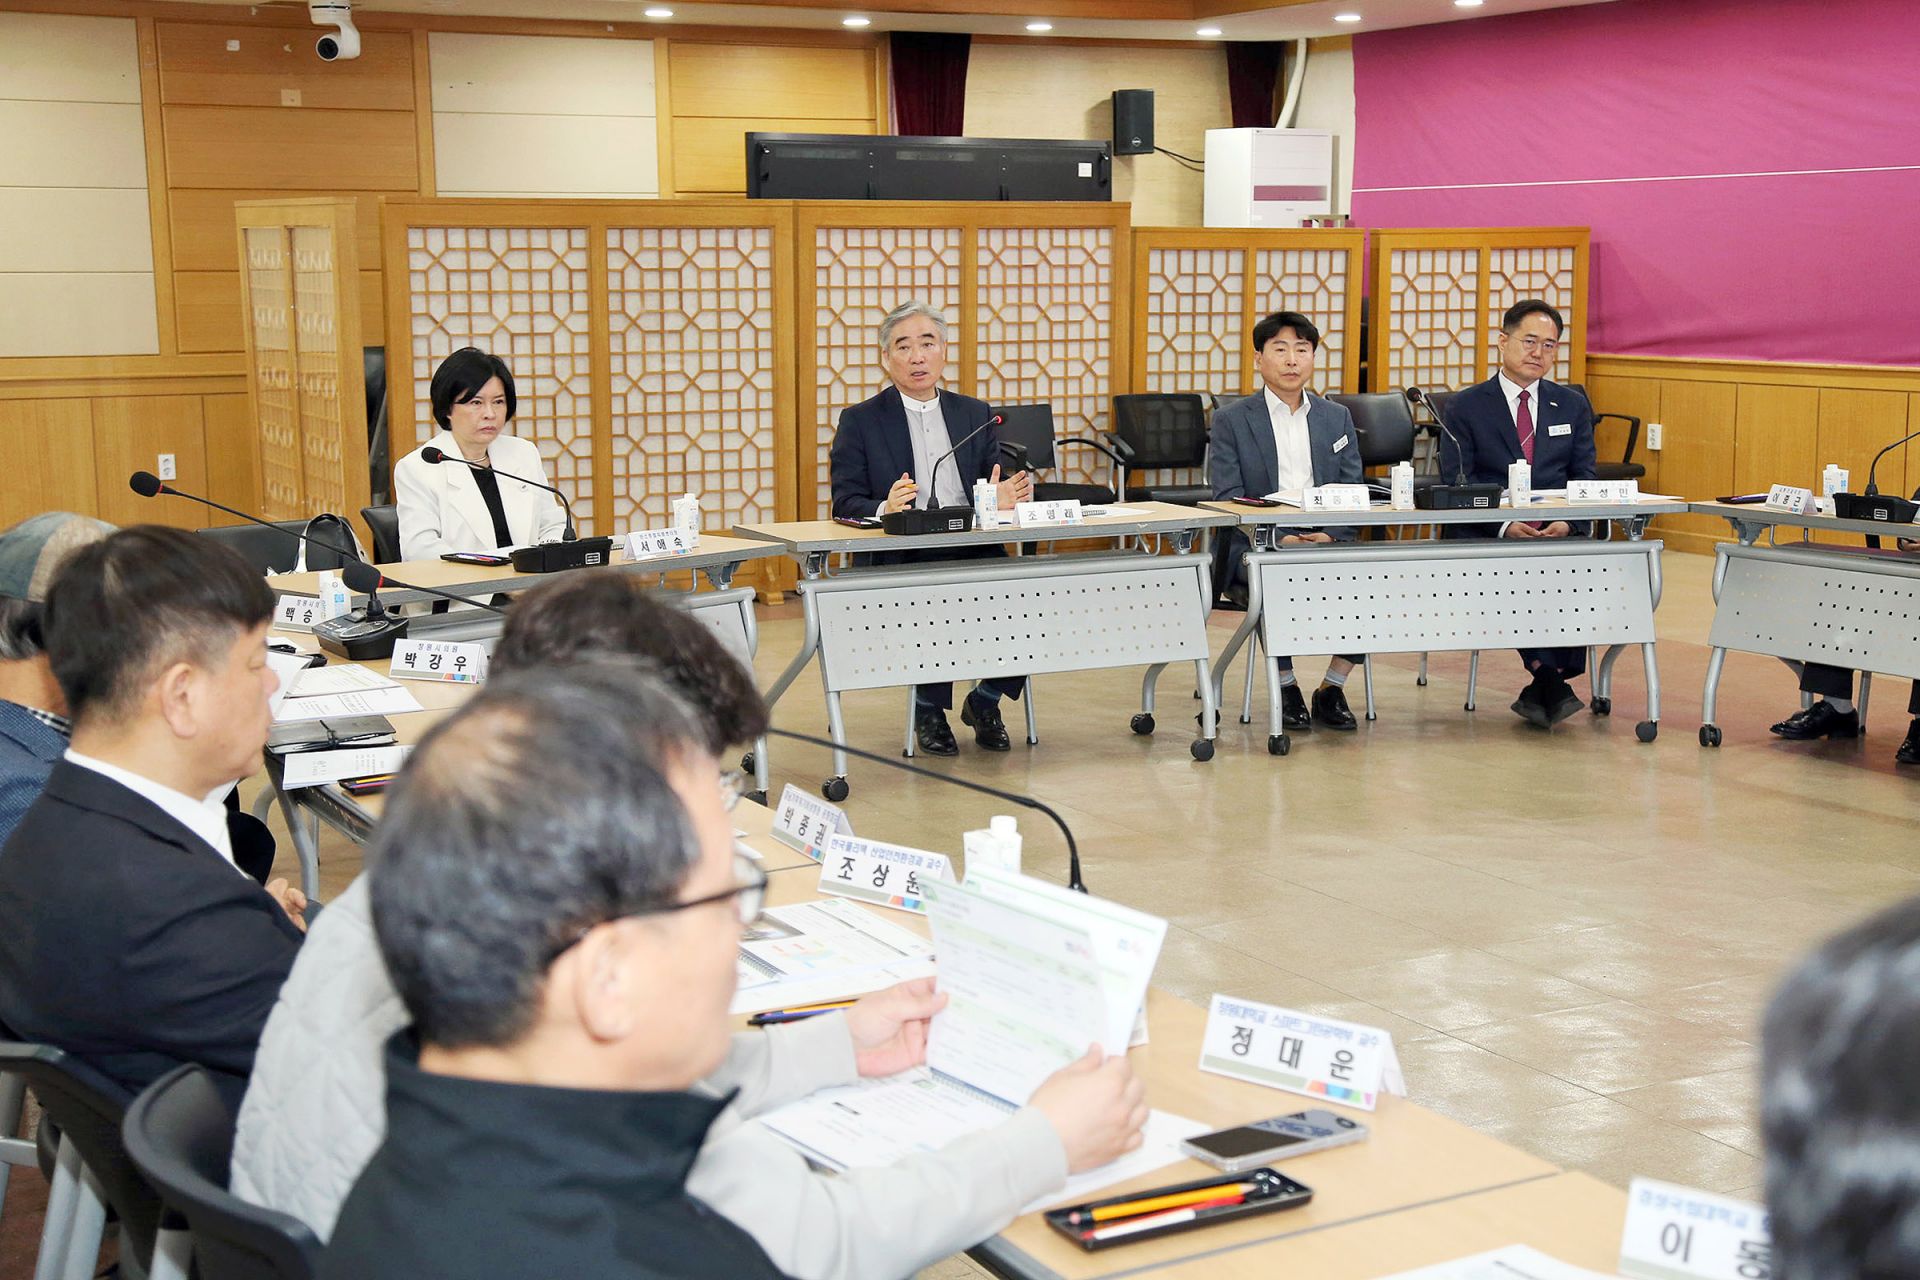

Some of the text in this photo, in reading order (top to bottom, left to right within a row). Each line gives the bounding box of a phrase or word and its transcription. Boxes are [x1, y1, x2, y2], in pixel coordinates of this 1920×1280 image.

[285, 606, 313, 624] 백승
[404, 652, 467, 672] 박강우
[1231, 1025, 1354, 1081] 정대운
